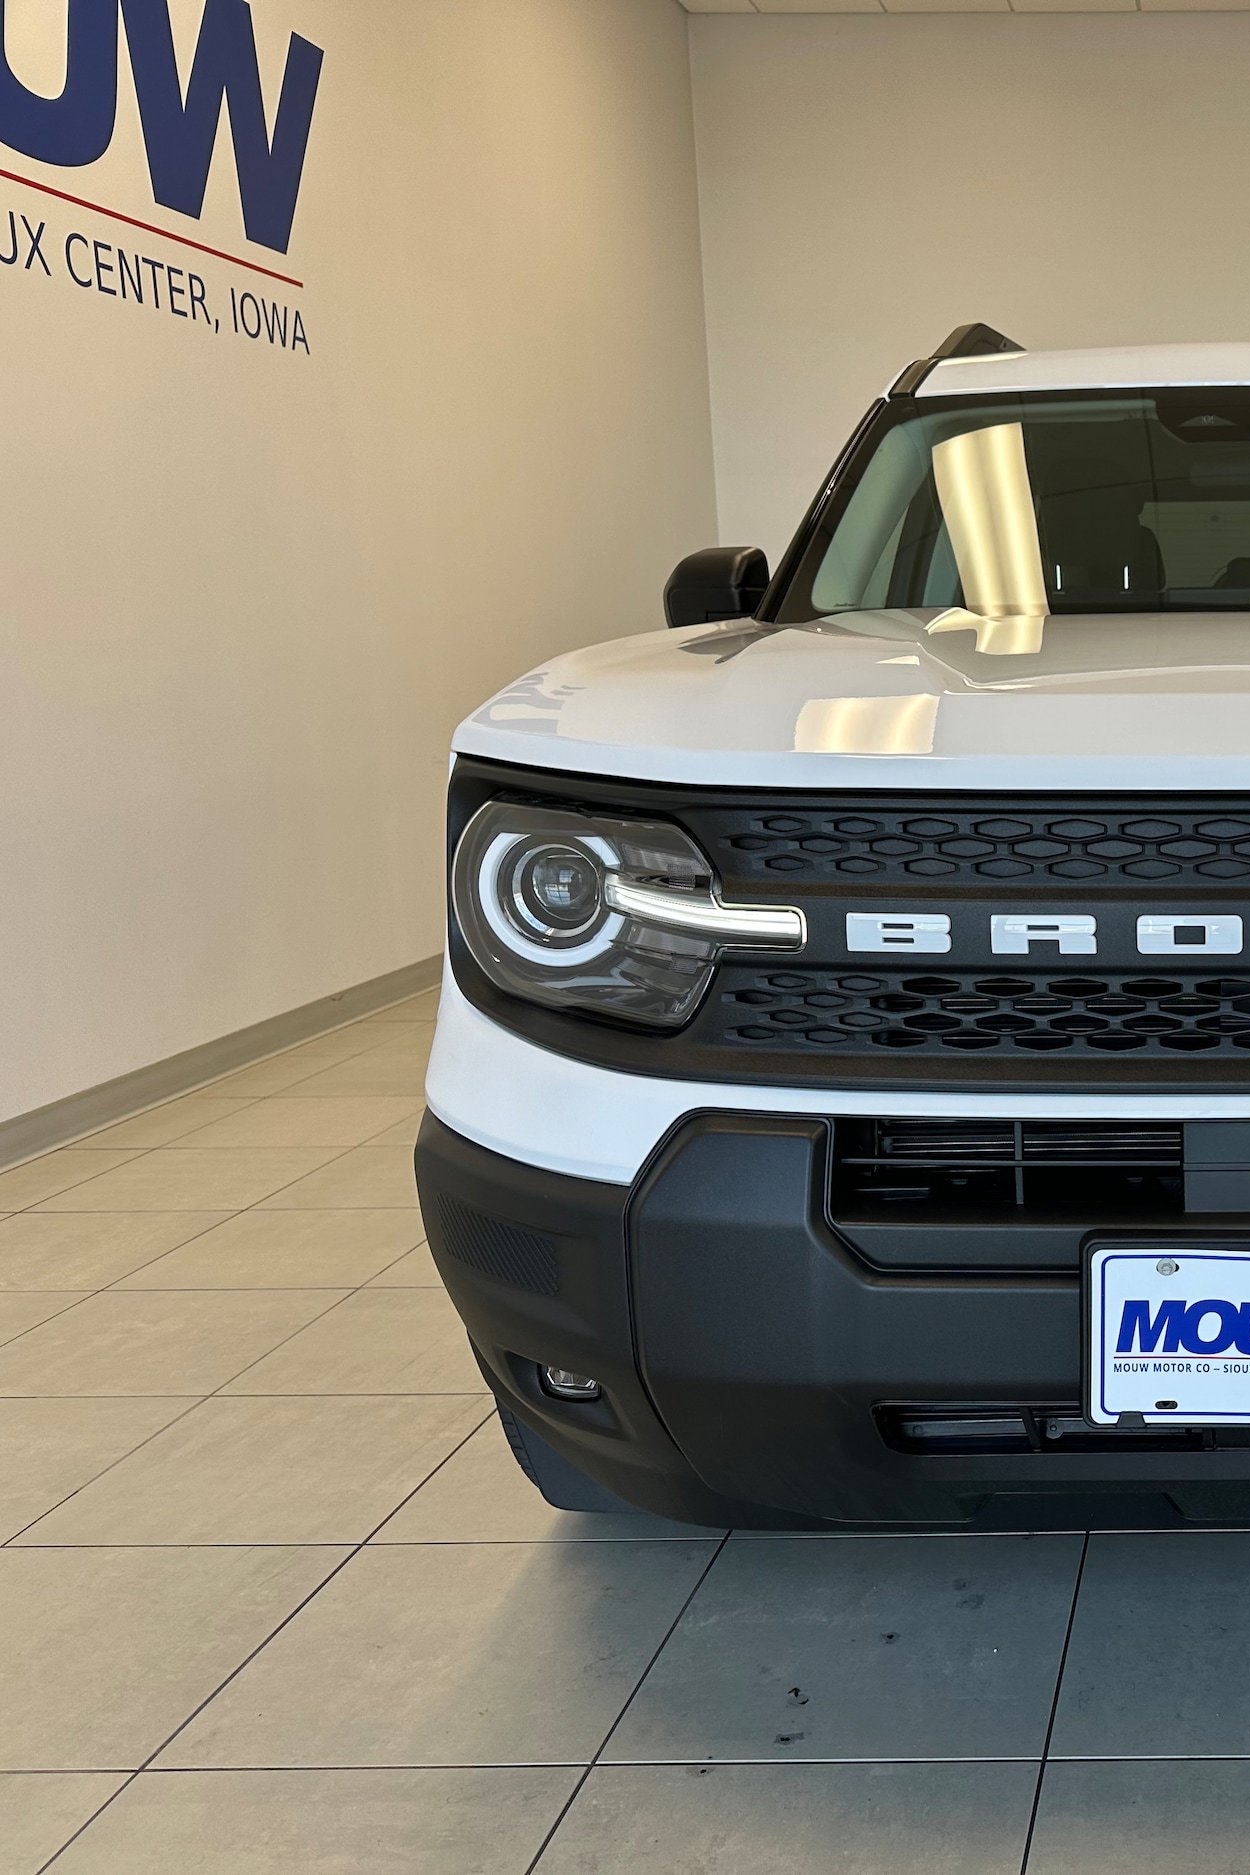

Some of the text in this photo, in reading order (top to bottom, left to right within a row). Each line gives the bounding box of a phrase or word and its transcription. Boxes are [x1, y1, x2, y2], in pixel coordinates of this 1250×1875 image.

[65, 232, 220, 334] CENTER,
[230, 287, 310, 355] IOWA
[1113, 1363, 1149, 1373] MOUW
[1153, 1363, 1192, 1373] MOTOR
[1196, 1363, 1210, 1373] CO
